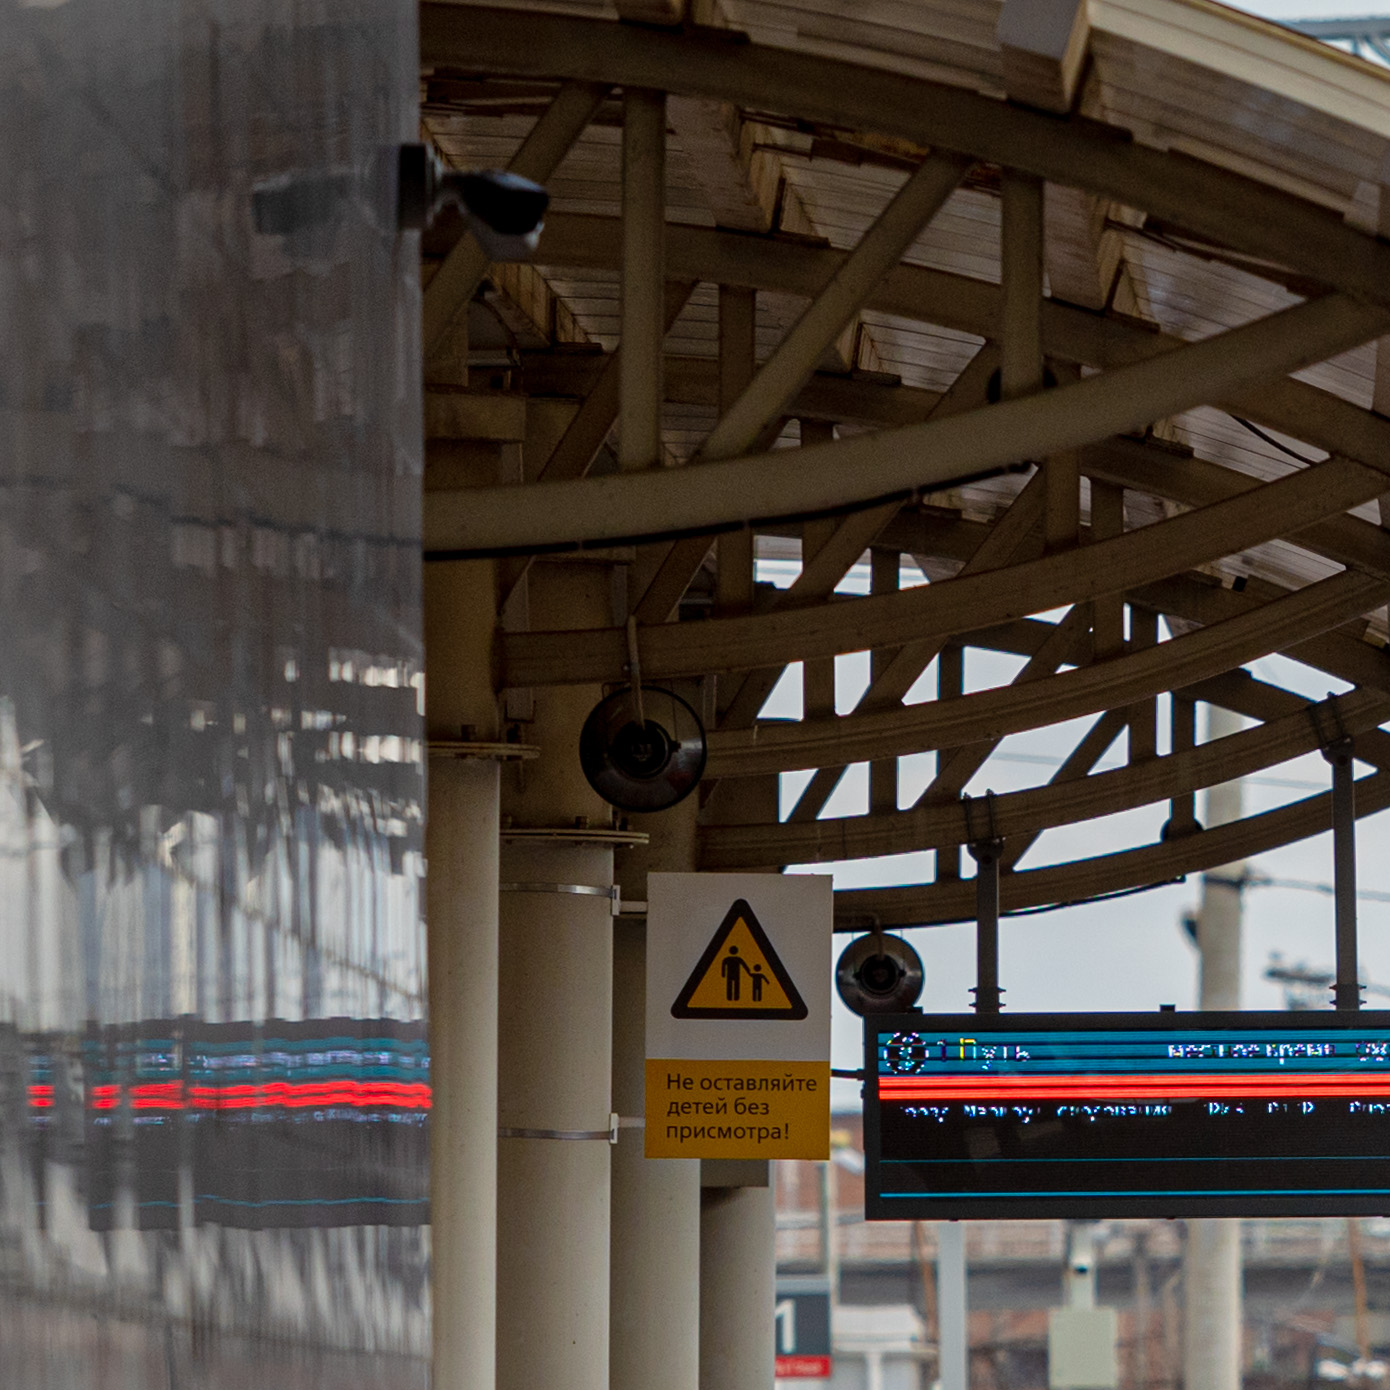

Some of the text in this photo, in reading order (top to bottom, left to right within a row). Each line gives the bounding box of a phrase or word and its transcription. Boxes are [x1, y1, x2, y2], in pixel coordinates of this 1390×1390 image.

[666, 1073, 817, 1091] Не оставляйте
[666, 1097, 770, 1117] детей без
[666, 1123, 789, 1143] присмотра!
[775, 1298, 796, 1354] 1
